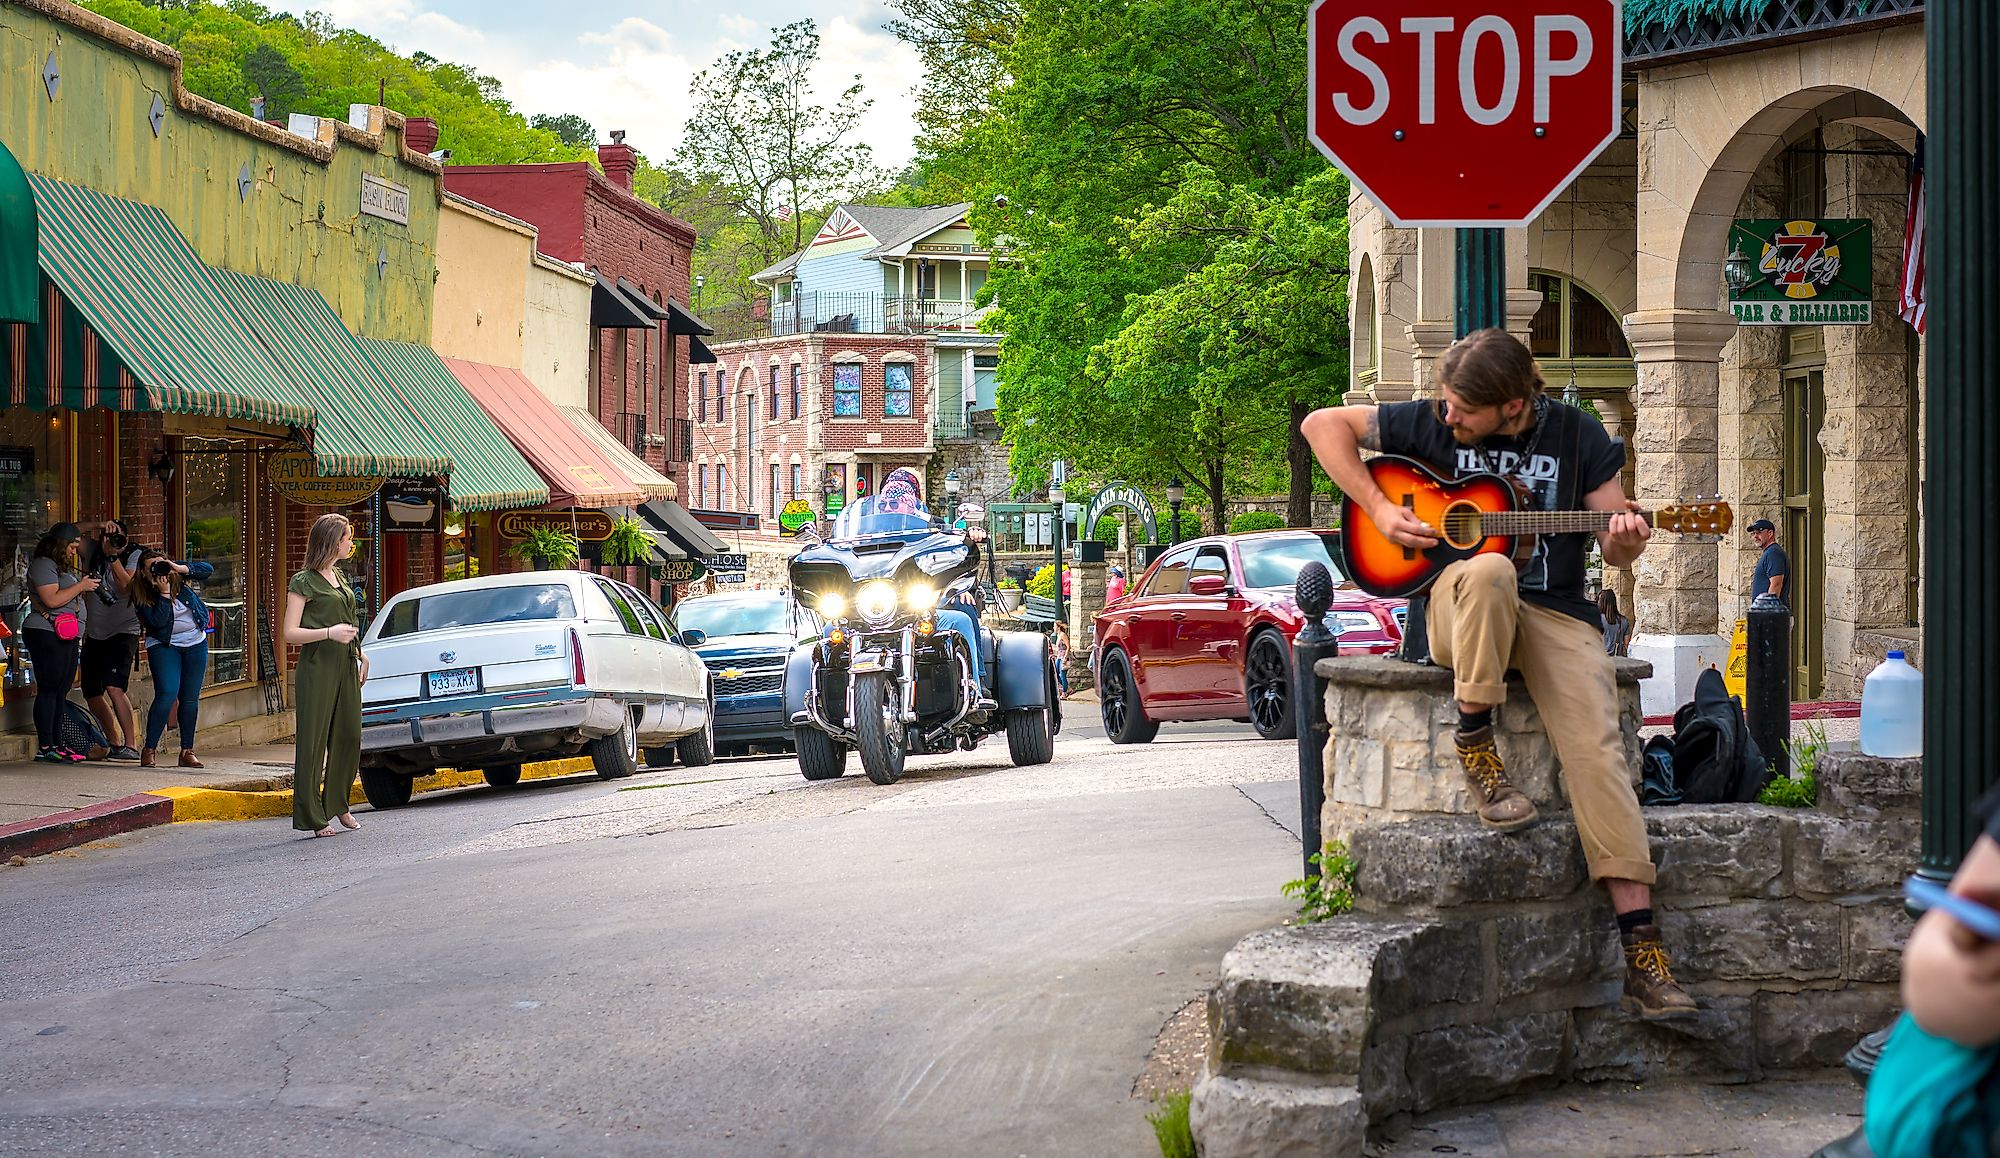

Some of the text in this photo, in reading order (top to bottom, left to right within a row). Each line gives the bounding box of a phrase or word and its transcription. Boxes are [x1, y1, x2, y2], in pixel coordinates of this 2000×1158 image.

[1332, 15, 1593, 125] STOP
[1758, 245, 1842, 285] Lucky
[1775, 232, 1828, 285] 7
[1832, 290, 1852, 300] FLOOR
[1734, 304, 1869, 322] BAR & BILLIARDS
[9, 460, 21, 470] TUB
[1456, 449, 1560, 478] THE DUD
[504, 516, 607, 534] Christopher's
[660, 562, 694, 571] TOWN
[660, 570, 693, 580] SHOP
[431, 674, 475, 691] 933 XKX
